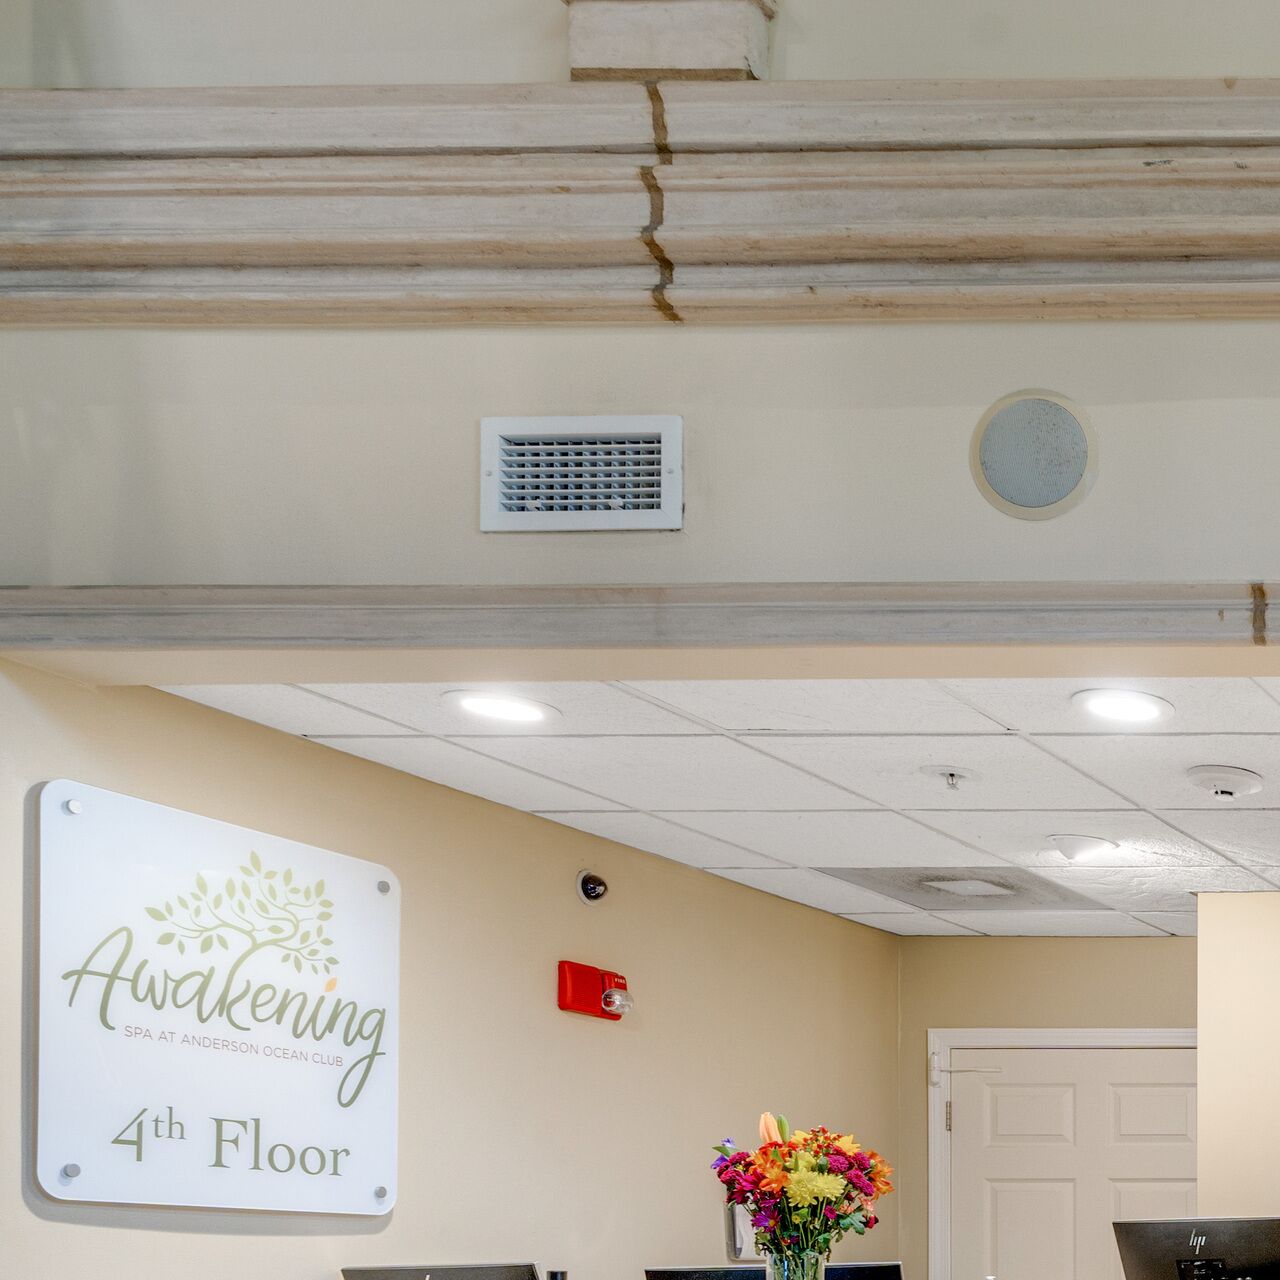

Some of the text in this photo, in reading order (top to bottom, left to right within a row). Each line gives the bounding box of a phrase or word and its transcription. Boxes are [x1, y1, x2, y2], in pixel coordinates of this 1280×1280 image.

[61, 926, 386, 1108] Awakening
[124, 1025, 344, 1068] SPA AT ANDERSON OCEAN CLUB
[111, 1106, 351, 1177] 4th Floor
